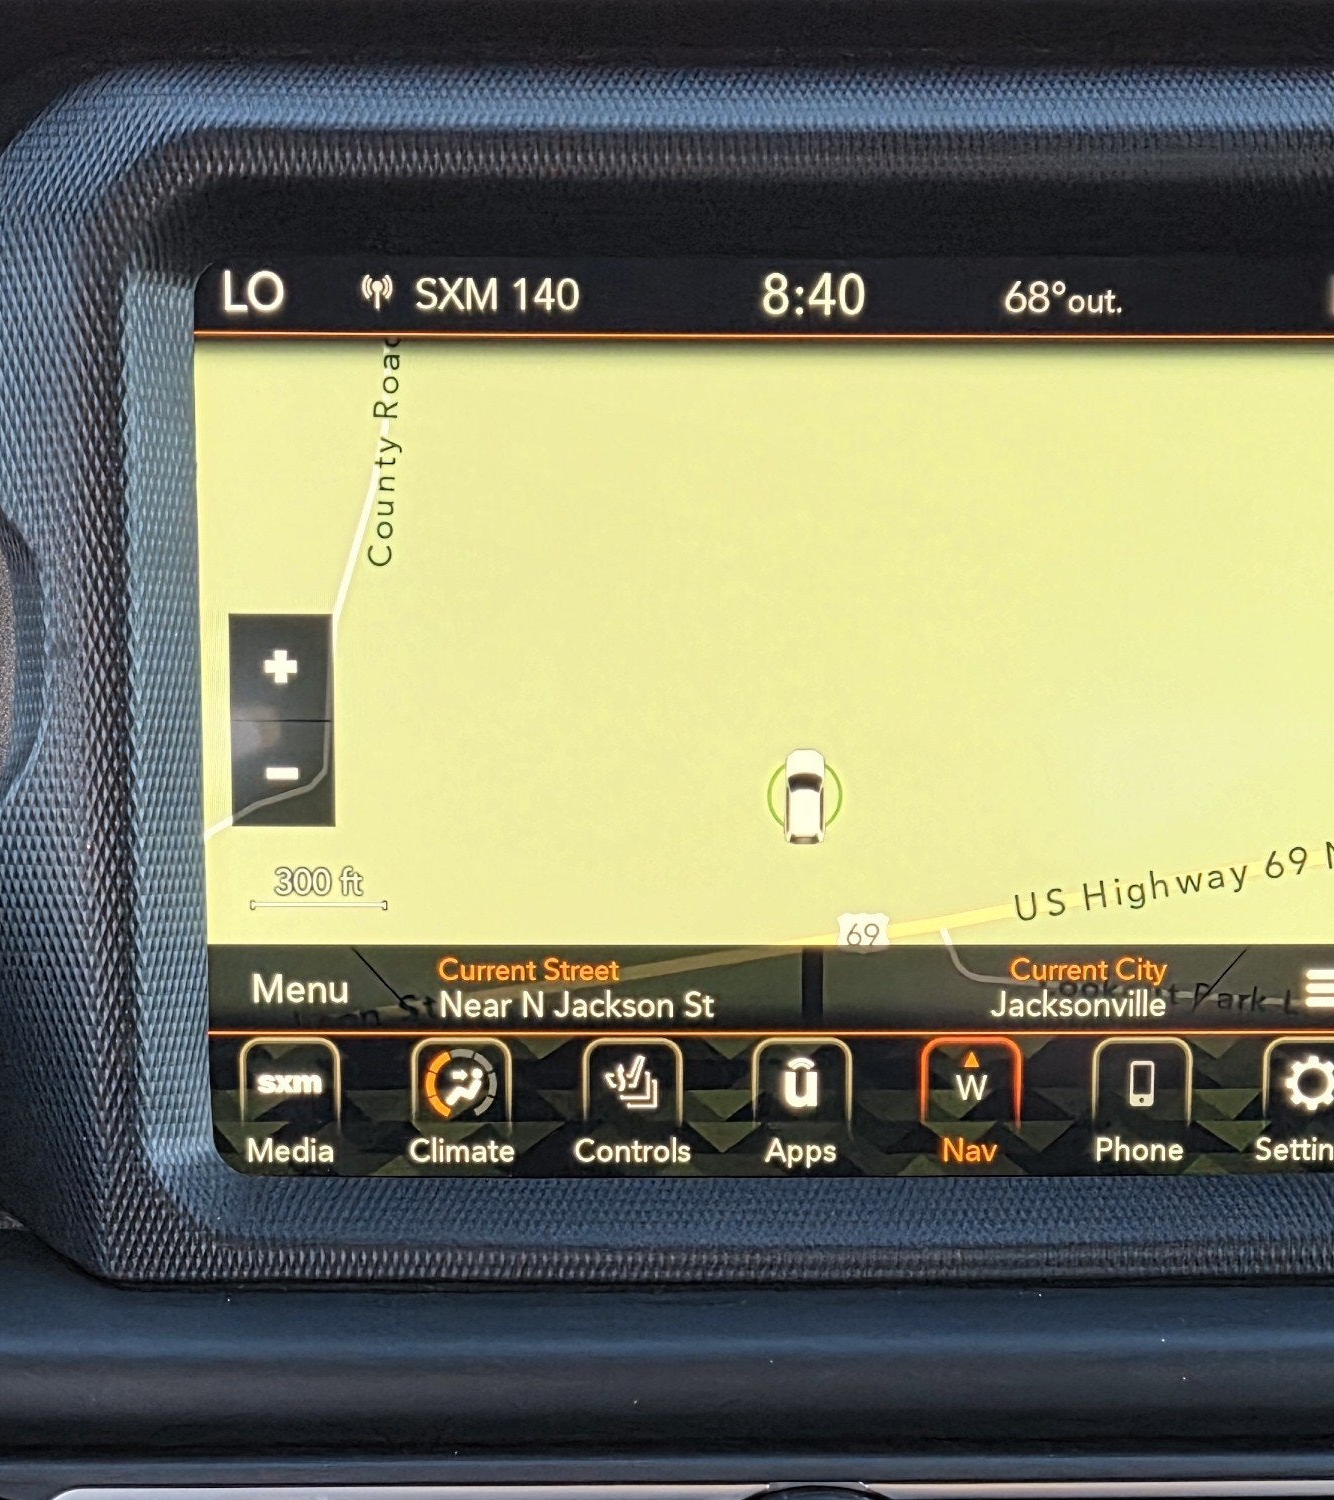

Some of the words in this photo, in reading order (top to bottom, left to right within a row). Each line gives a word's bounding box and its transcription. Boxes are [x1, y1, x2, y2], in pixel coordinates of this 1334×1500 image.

[222, 269, 285, 314] LO
[415, 276, 498, 312] SXM
[513, 277, 580, 312] 140
[762, 272, 865, 317] 8:40
[367, 436, 403, 567] County
[273, 866, 333, 898] 300
[339, 864, 365, 898] ft
[1014, 887, 1066, 922] US
[1082, 865, 1248, 911] Highway
[1265, 846, 1308, 879] 69
[844, 920, 881, 948] 69
[437, 957, 537, 982] Current
[543, 957, 620, 982] Street
[1010, 957, 1109, 982] Current
[1115, 956, 1168, 987] City
[252, 972, 349, 1004] Menu
[439, 990, 513, 1018] Near
[521, 990, 544, 1018] N
[553, 989, 674, 1018] Jackson
[683, 990, 715, 1018] St
[990, 988, 1167, 1018] Jacksonville
[256, 1073, 323, 1095] sxm
[955, 1074, 988, 1101] W
[245, 1136, 334, 1163] Media
[408, 1136, 515, 1163] Climate
[573, 1136, 691, 1164] Controls
[764, 1137, 837, 1169] Apps
[942, 1136, 998, 1163] Nav
[1095, 1135, 1184, 1162] Phone
